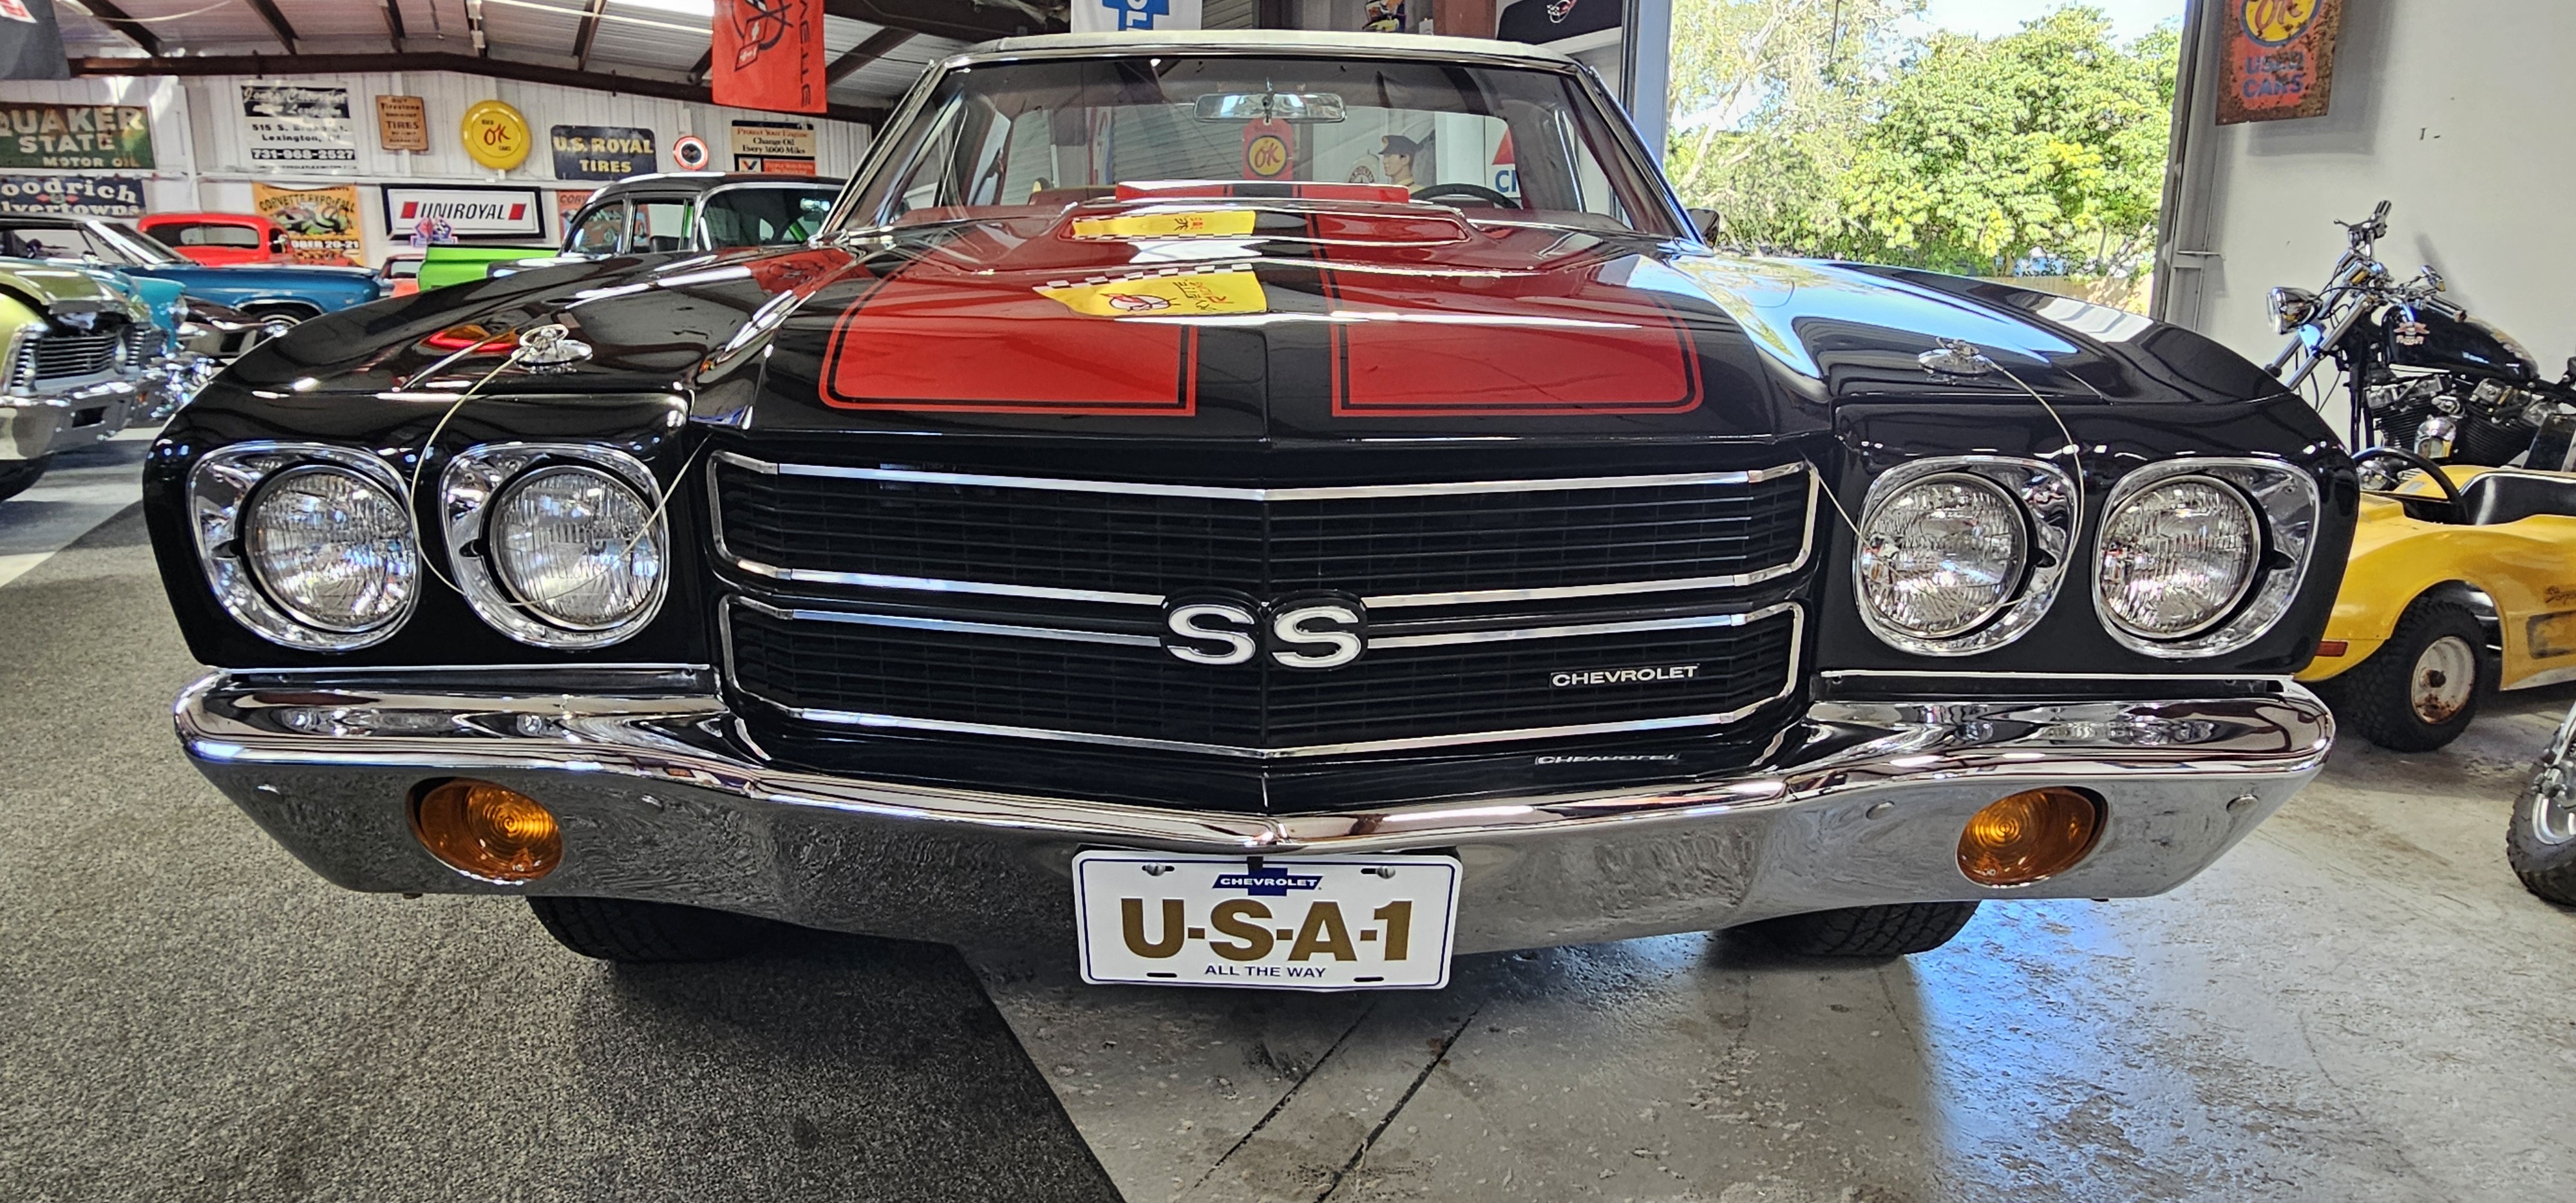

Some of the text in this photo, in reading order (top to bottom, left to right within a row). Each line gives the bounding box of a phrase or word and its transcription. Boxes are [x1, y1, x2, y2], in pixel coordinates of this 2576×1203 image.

[2243, 74, 2305, 98] CARS
[386, 120, 419, 129] TIRES
[261, 134, 322, 142] Lexington,
[483, 122, 512, 146] OK
[753, 137, 782, 146] Change
[18, 133, 116, 153] STATE
[553, 136, 654, 155] U.S. ROYAL
[742, 145, 762, 153] Every
[43, 156, 141, 167] MOTOR OIL
[1254, 142, 1281, 169] OK
[580, 159, 632, 173] TIRES
[420, 203, 506, 220] UNIROYAL
[325, 240, 359, 249] 20-21
[1166, 603, 1361, 668] SS
[1552, 665, 1698, 687] CHEVROLET
[1219, 877, 1318, 887] CHEVROLET
[1121, 898, 1413, 961] U-S-A-1
[1204, 965, 1327, 978] ALL THE WAY
